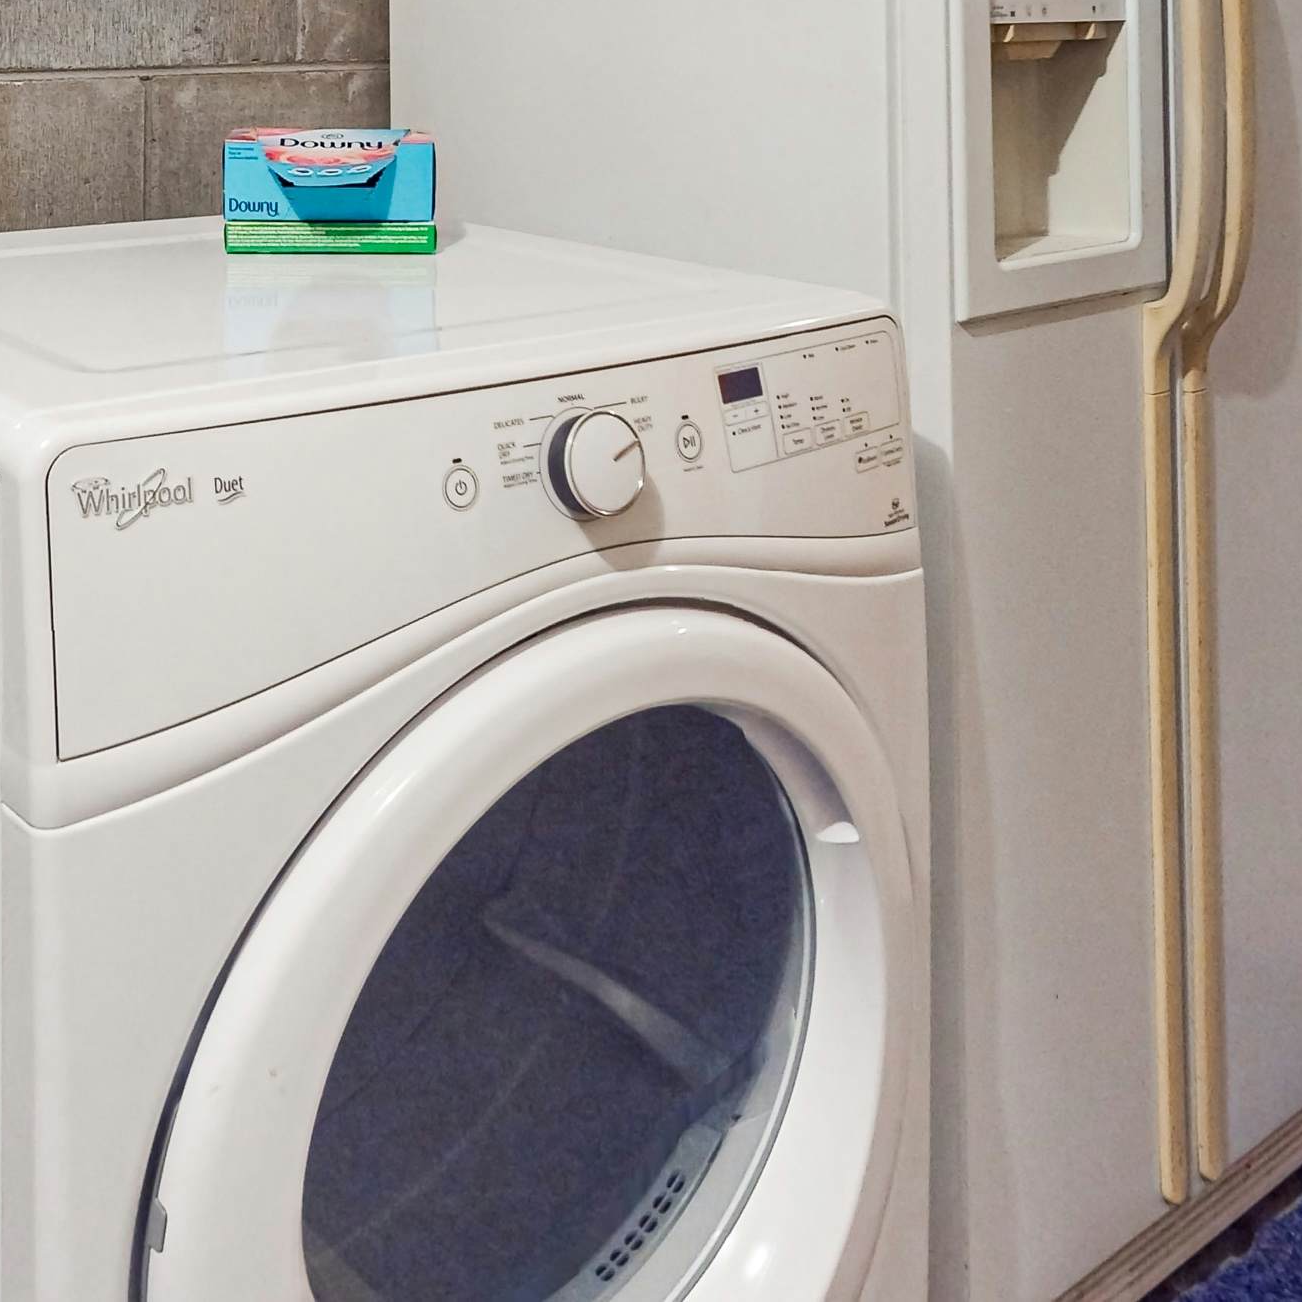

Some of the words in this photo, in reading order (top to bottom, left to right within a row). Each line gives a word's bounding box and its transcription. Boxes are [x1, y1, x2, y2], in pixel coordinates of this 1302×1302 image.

[279, 137, 383, 151] Downy
[228, 198, 279, 216] Downy
[75, 476, 194, 520] Whirlpool
[213, 476, 245, 495] Duet
